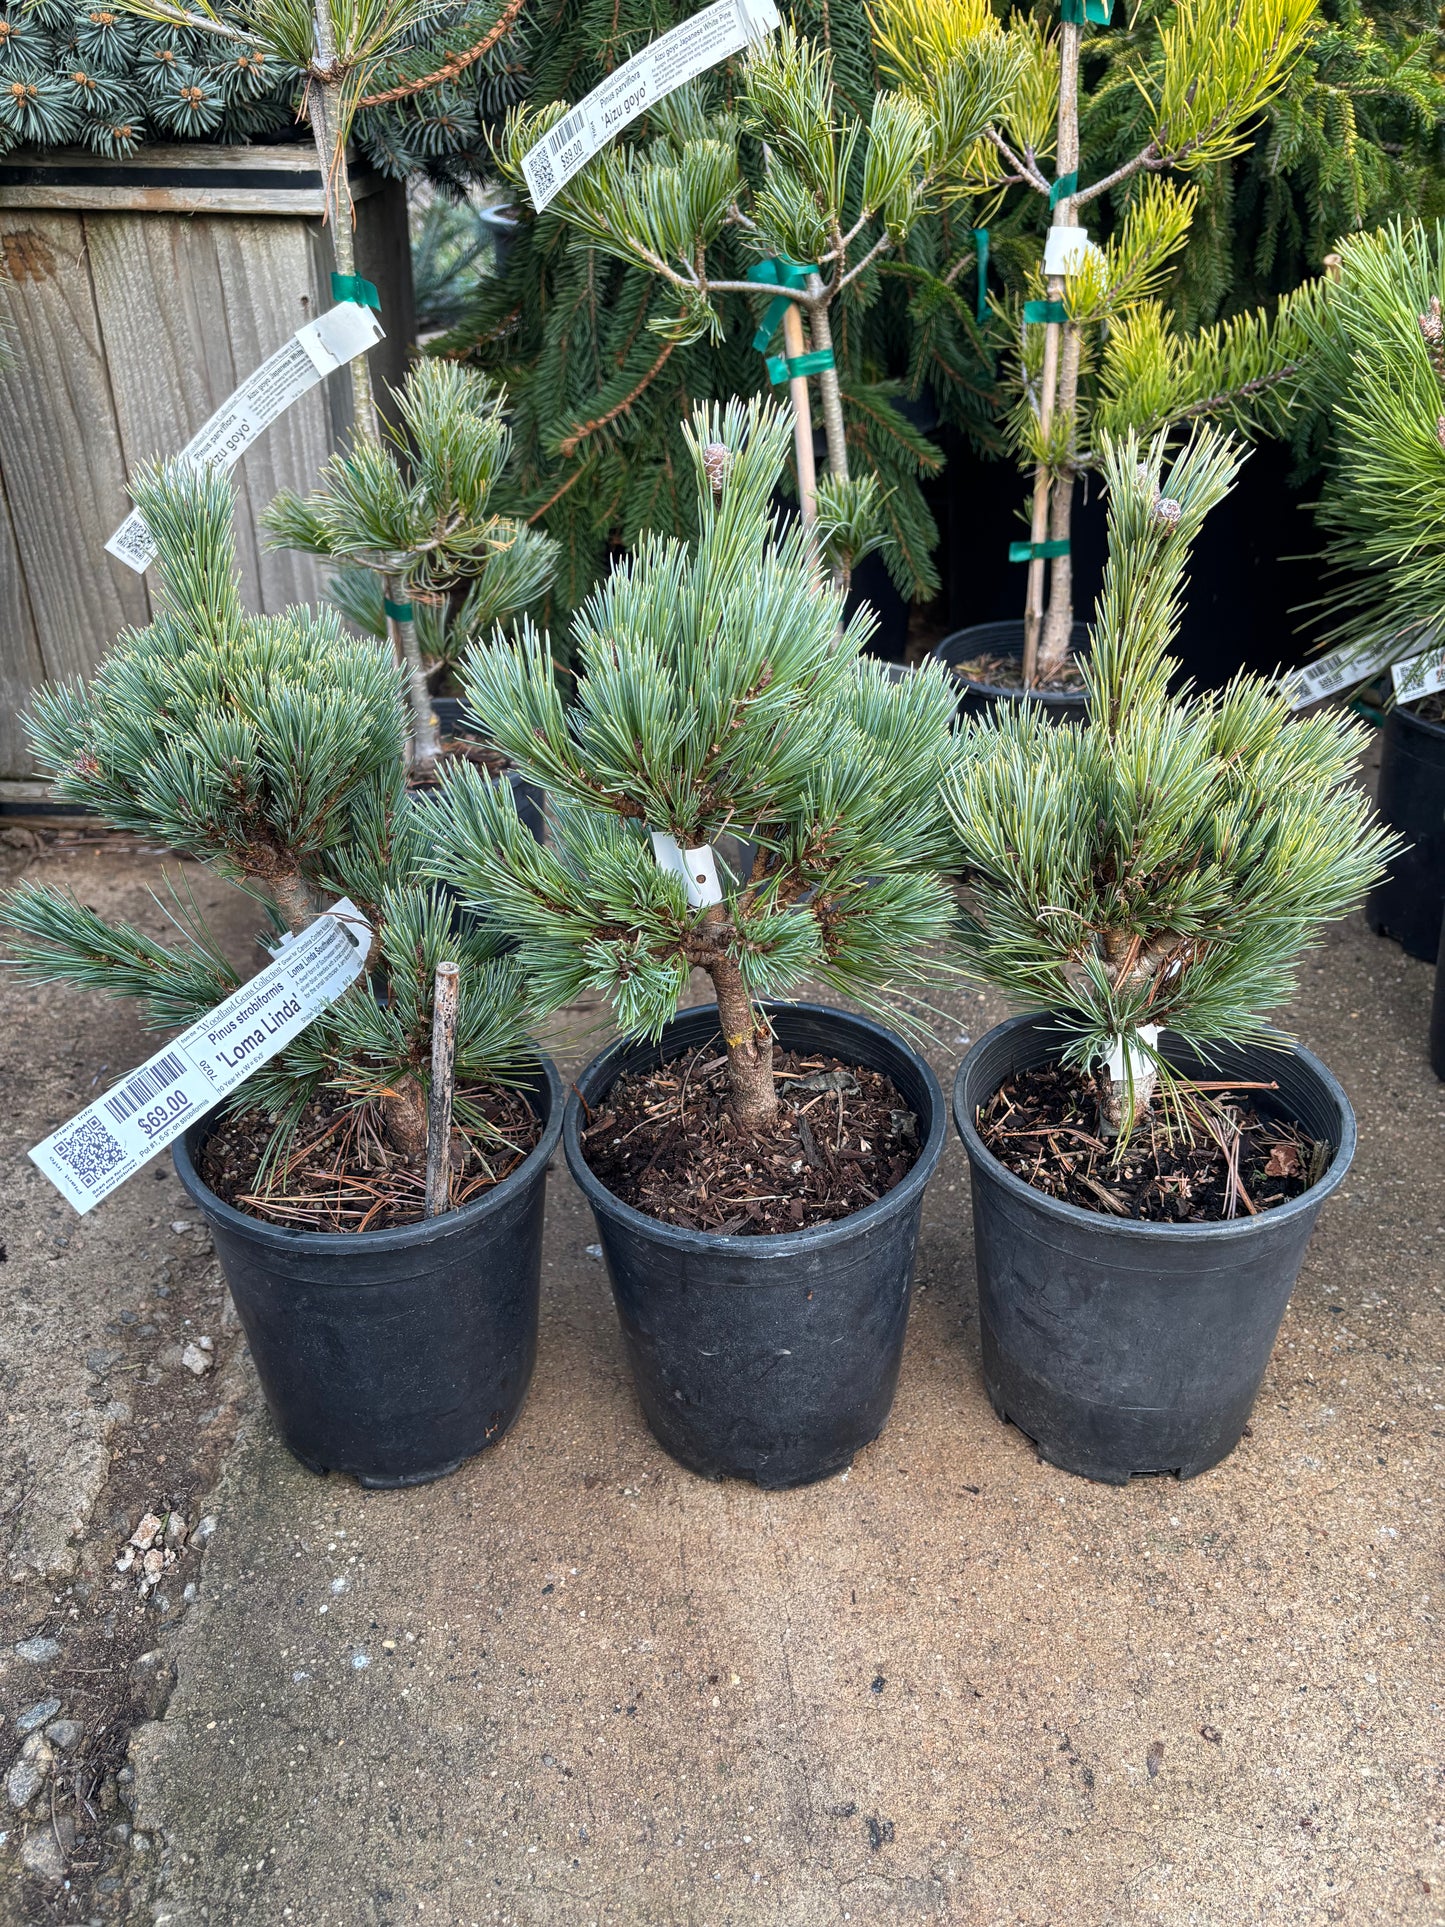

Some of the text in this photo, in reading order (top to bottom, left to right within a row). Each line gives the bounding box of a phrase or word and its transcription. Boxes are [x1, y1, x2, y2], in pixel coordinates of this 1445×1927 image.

[676, 26, 704, 48] Japanese
[701, 16, 719, 31] White
[716, 8, 732, 22] Pine
[598, 90, 615, 108] Pinus
[614, 70, 641, 97] parviflora
[601, 80, 647, 128] 'Aizu goyo'
[560, 139, 583, 168] $89.00
[193, 441, 212, 461] Pinus
[224, 419, 250, 451] goyo'
[286, 960, 304, 978] Loma
[300, 949, 317, 966] Linda
[195, 1000, 236, 1034] "Woodland
[233, 985, 255, 1005] Gems
[251, 962, 284, 991] Collection"
[207, 1017, 238, 1046] Pinus
[233, 979, 285, 1025] strobiformis
[215, 1024, 267, 1071] 'Loma
[260, 991, 304, 1034] Linda'
[198, 1058, 218, 1081] 7020
[222, 1075, 237, 1088] Year
[242, 1063, 251, 1071] W
[52, 1107, 93, 1140] Plant Info
[135, 1087, 189, 1135] $69.00
[138, 1145, 151, 1157] Pot
[148, 1138, 160, 1149] #1,
[171, 1121, 181, 1131] on
[178, 1097, 210, 1125] strobiformis
[48, 1155, 82, 1195] Plant Info
